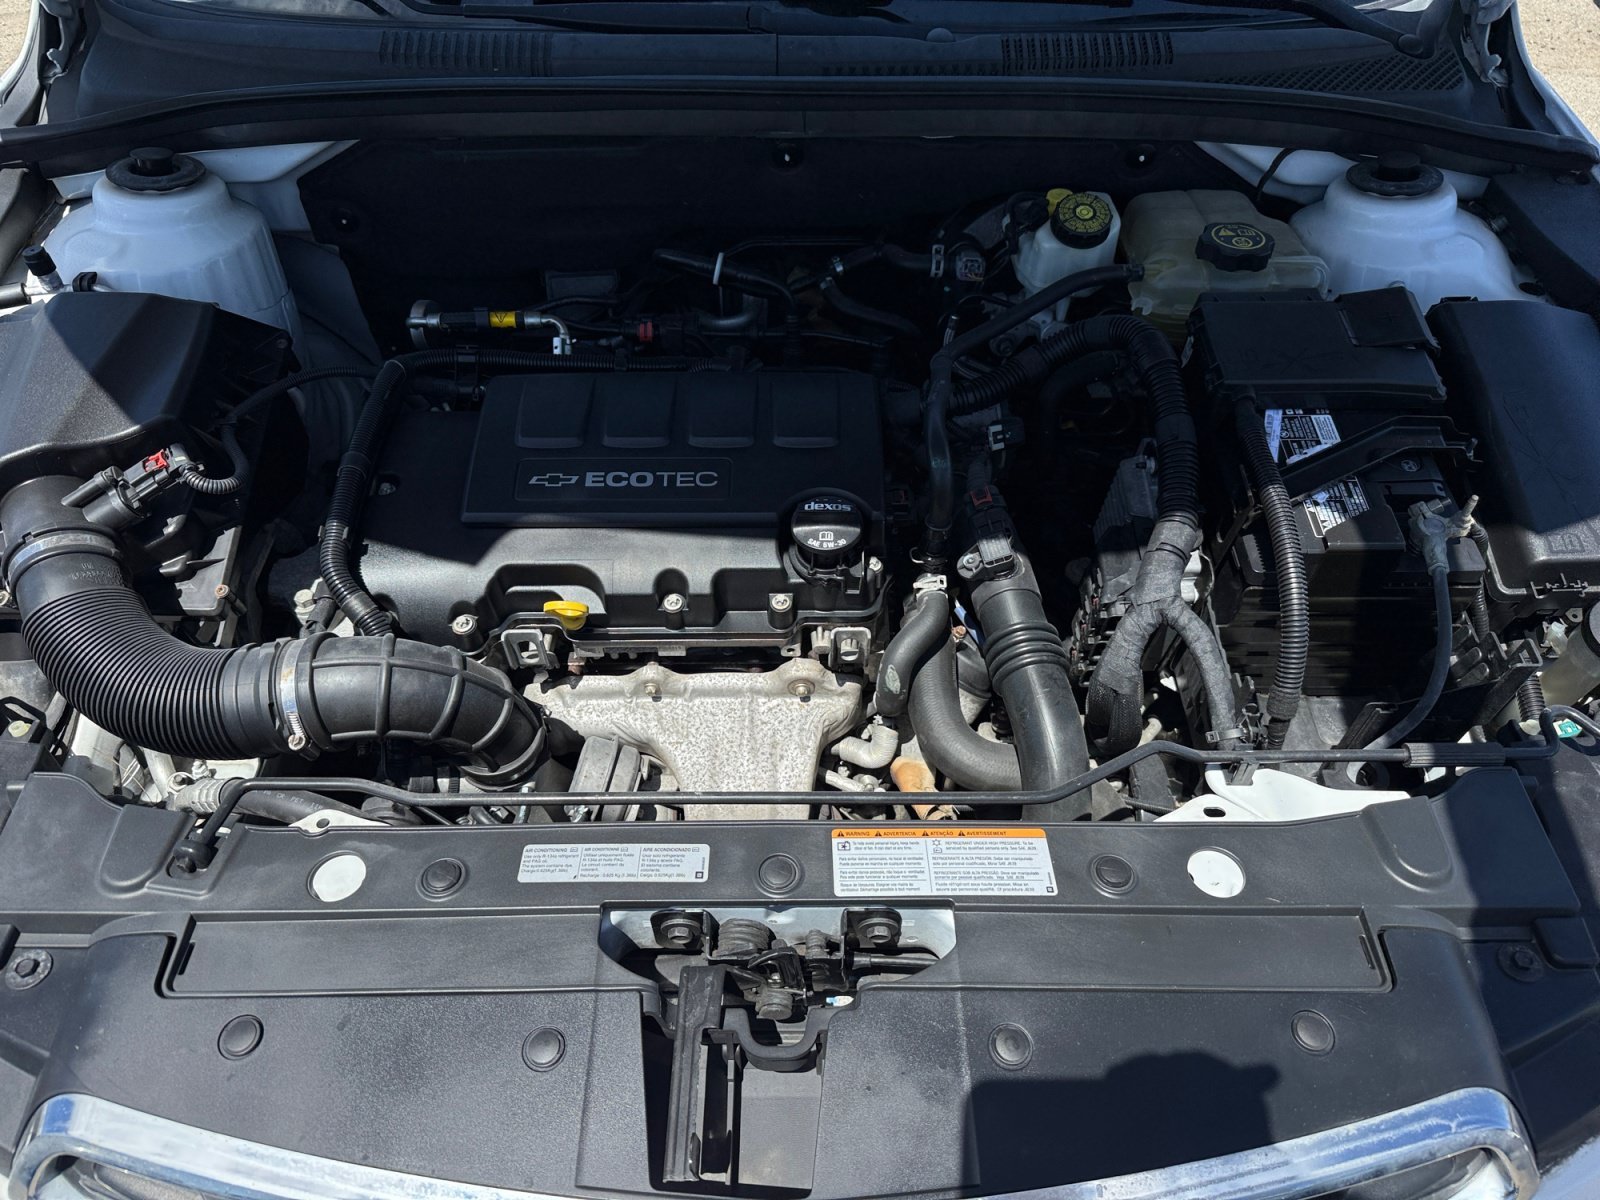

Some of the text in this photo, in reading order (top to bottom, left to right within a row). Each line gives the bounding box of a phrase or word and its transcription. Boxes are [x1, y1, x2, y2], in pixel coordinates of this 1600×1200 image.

[585, 471, 718, 487] ECOTEC
[804, 502, 852, 512] dexos
[808, 538, 847, 548] SAE 5W-30
